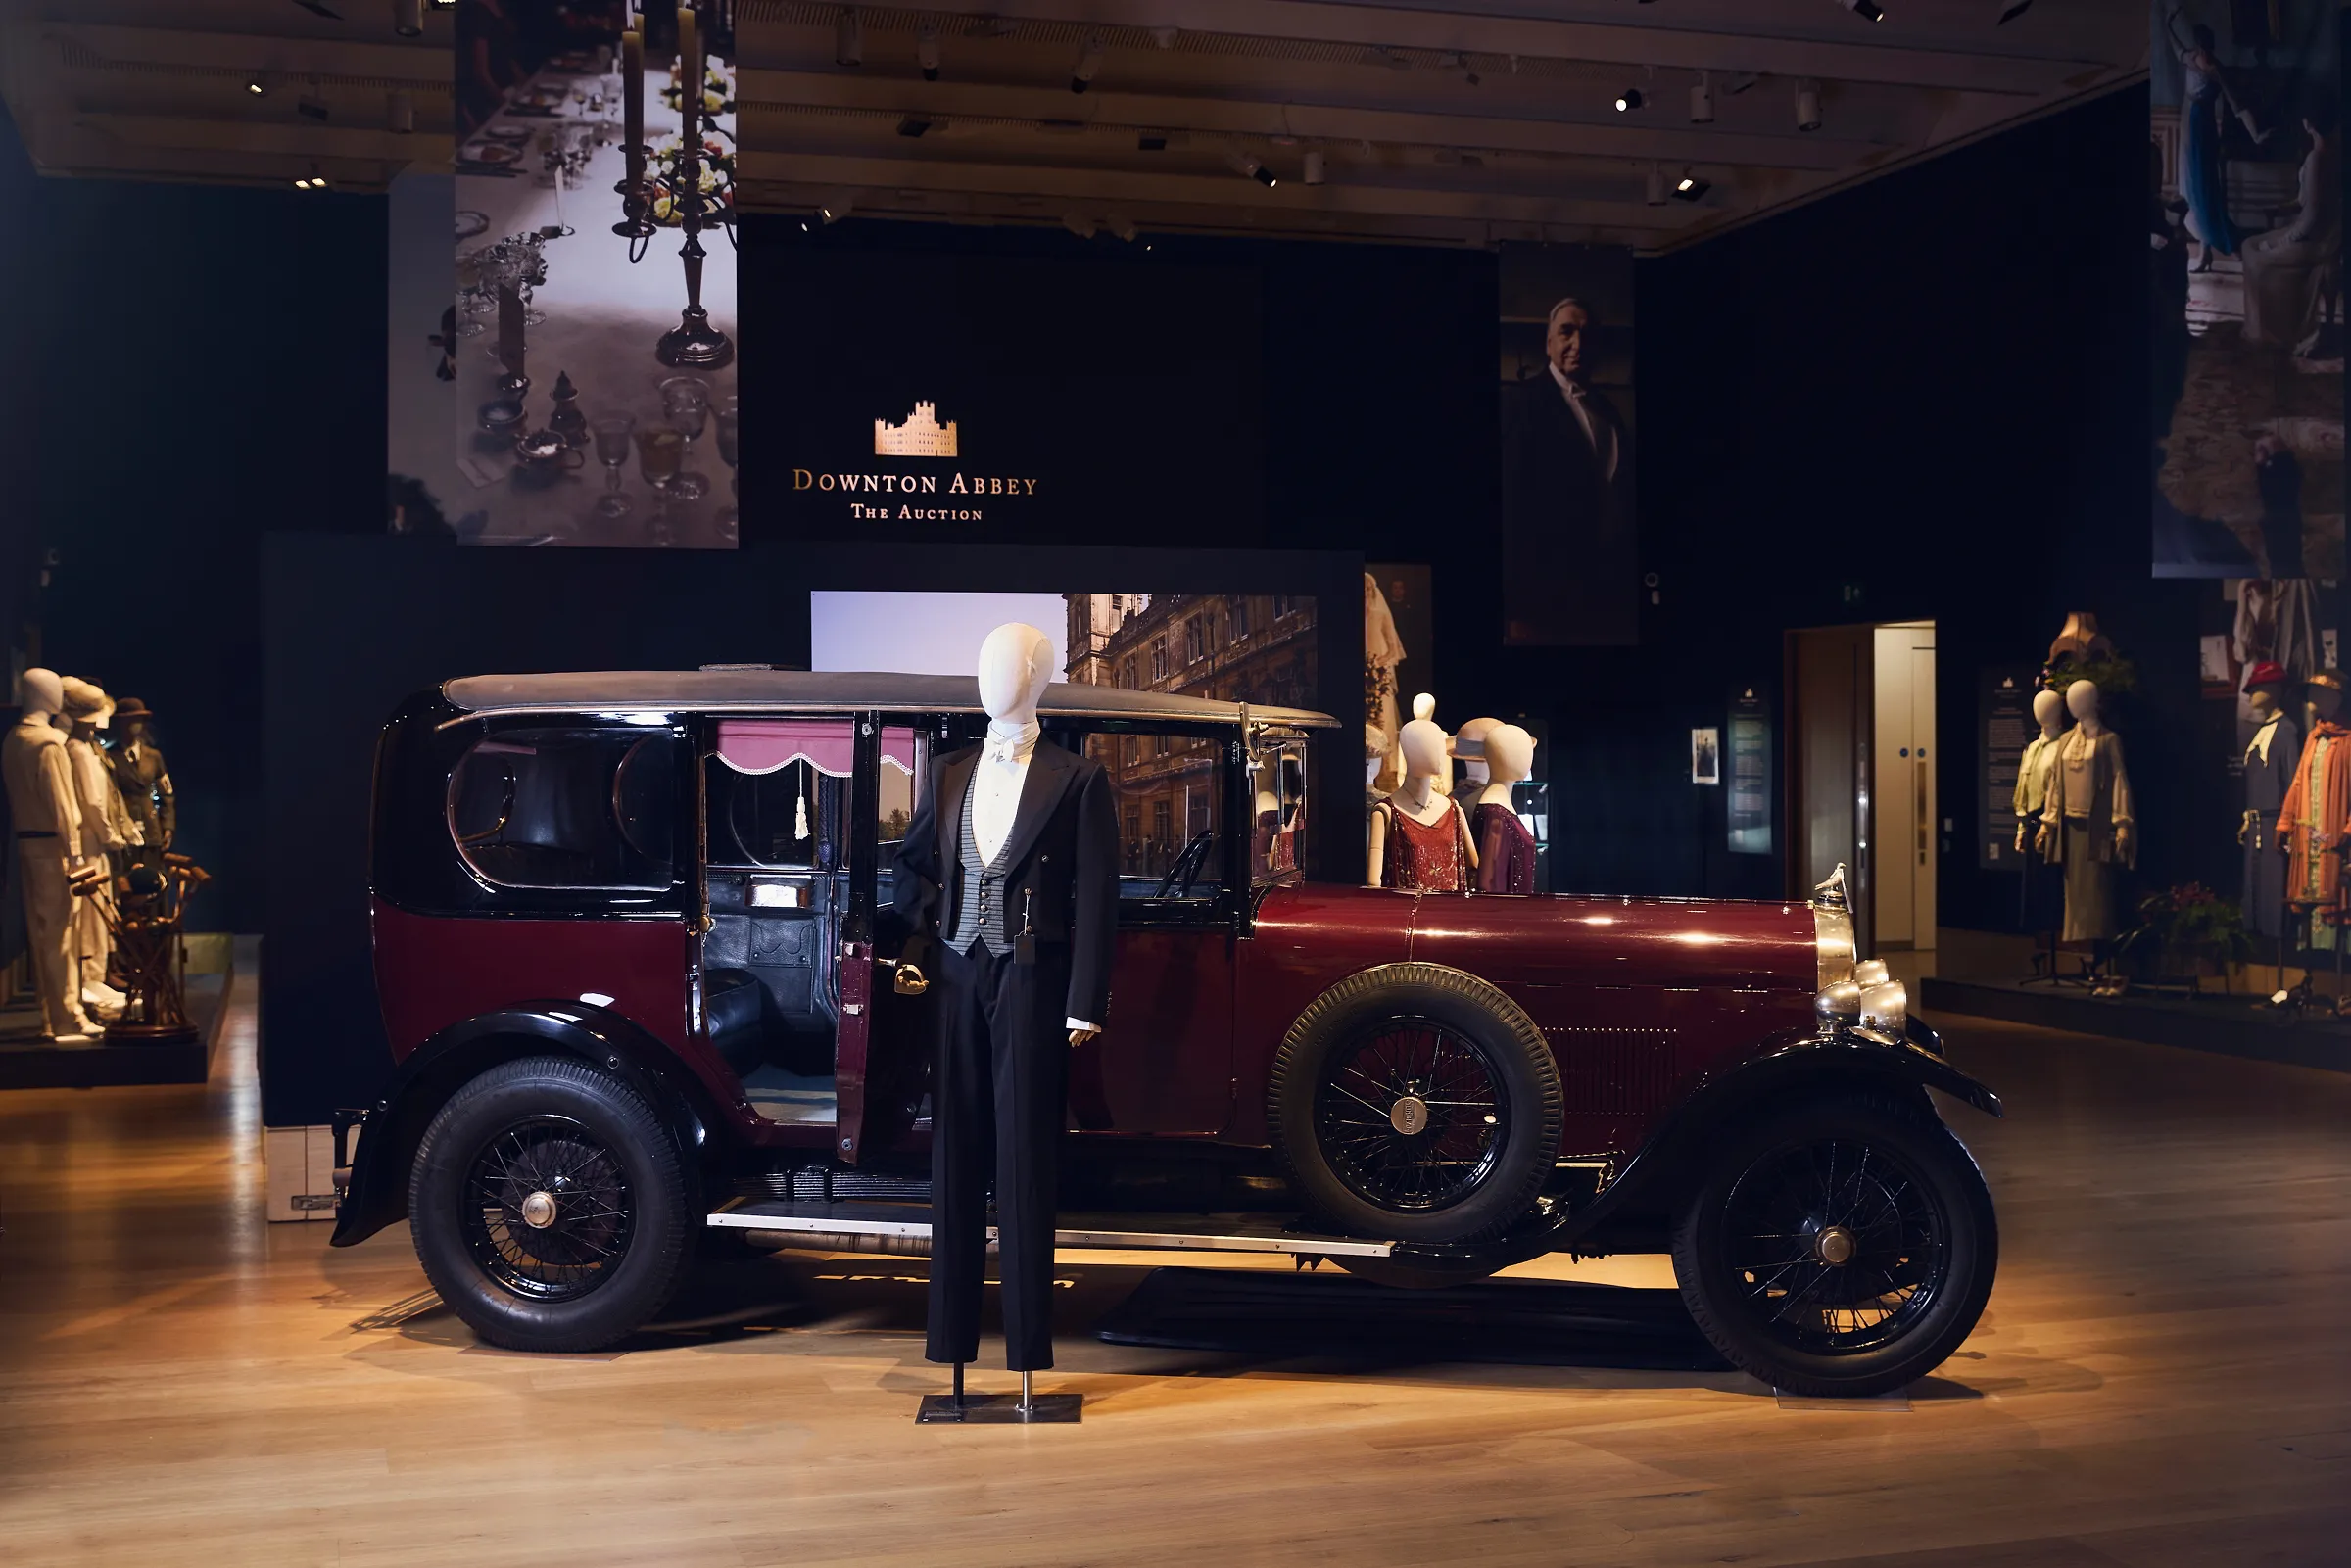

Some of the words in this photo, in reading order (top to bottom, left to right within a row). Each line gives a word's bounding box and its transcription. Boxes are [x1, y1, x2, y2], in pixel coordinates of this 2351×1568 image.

[792, 468, 936, 494] DOWNTON
[948, 471, 1039, 496] ABBEY
[850, 502, 888, 520] THE
[898, 504, 983, 521] AUCTION
